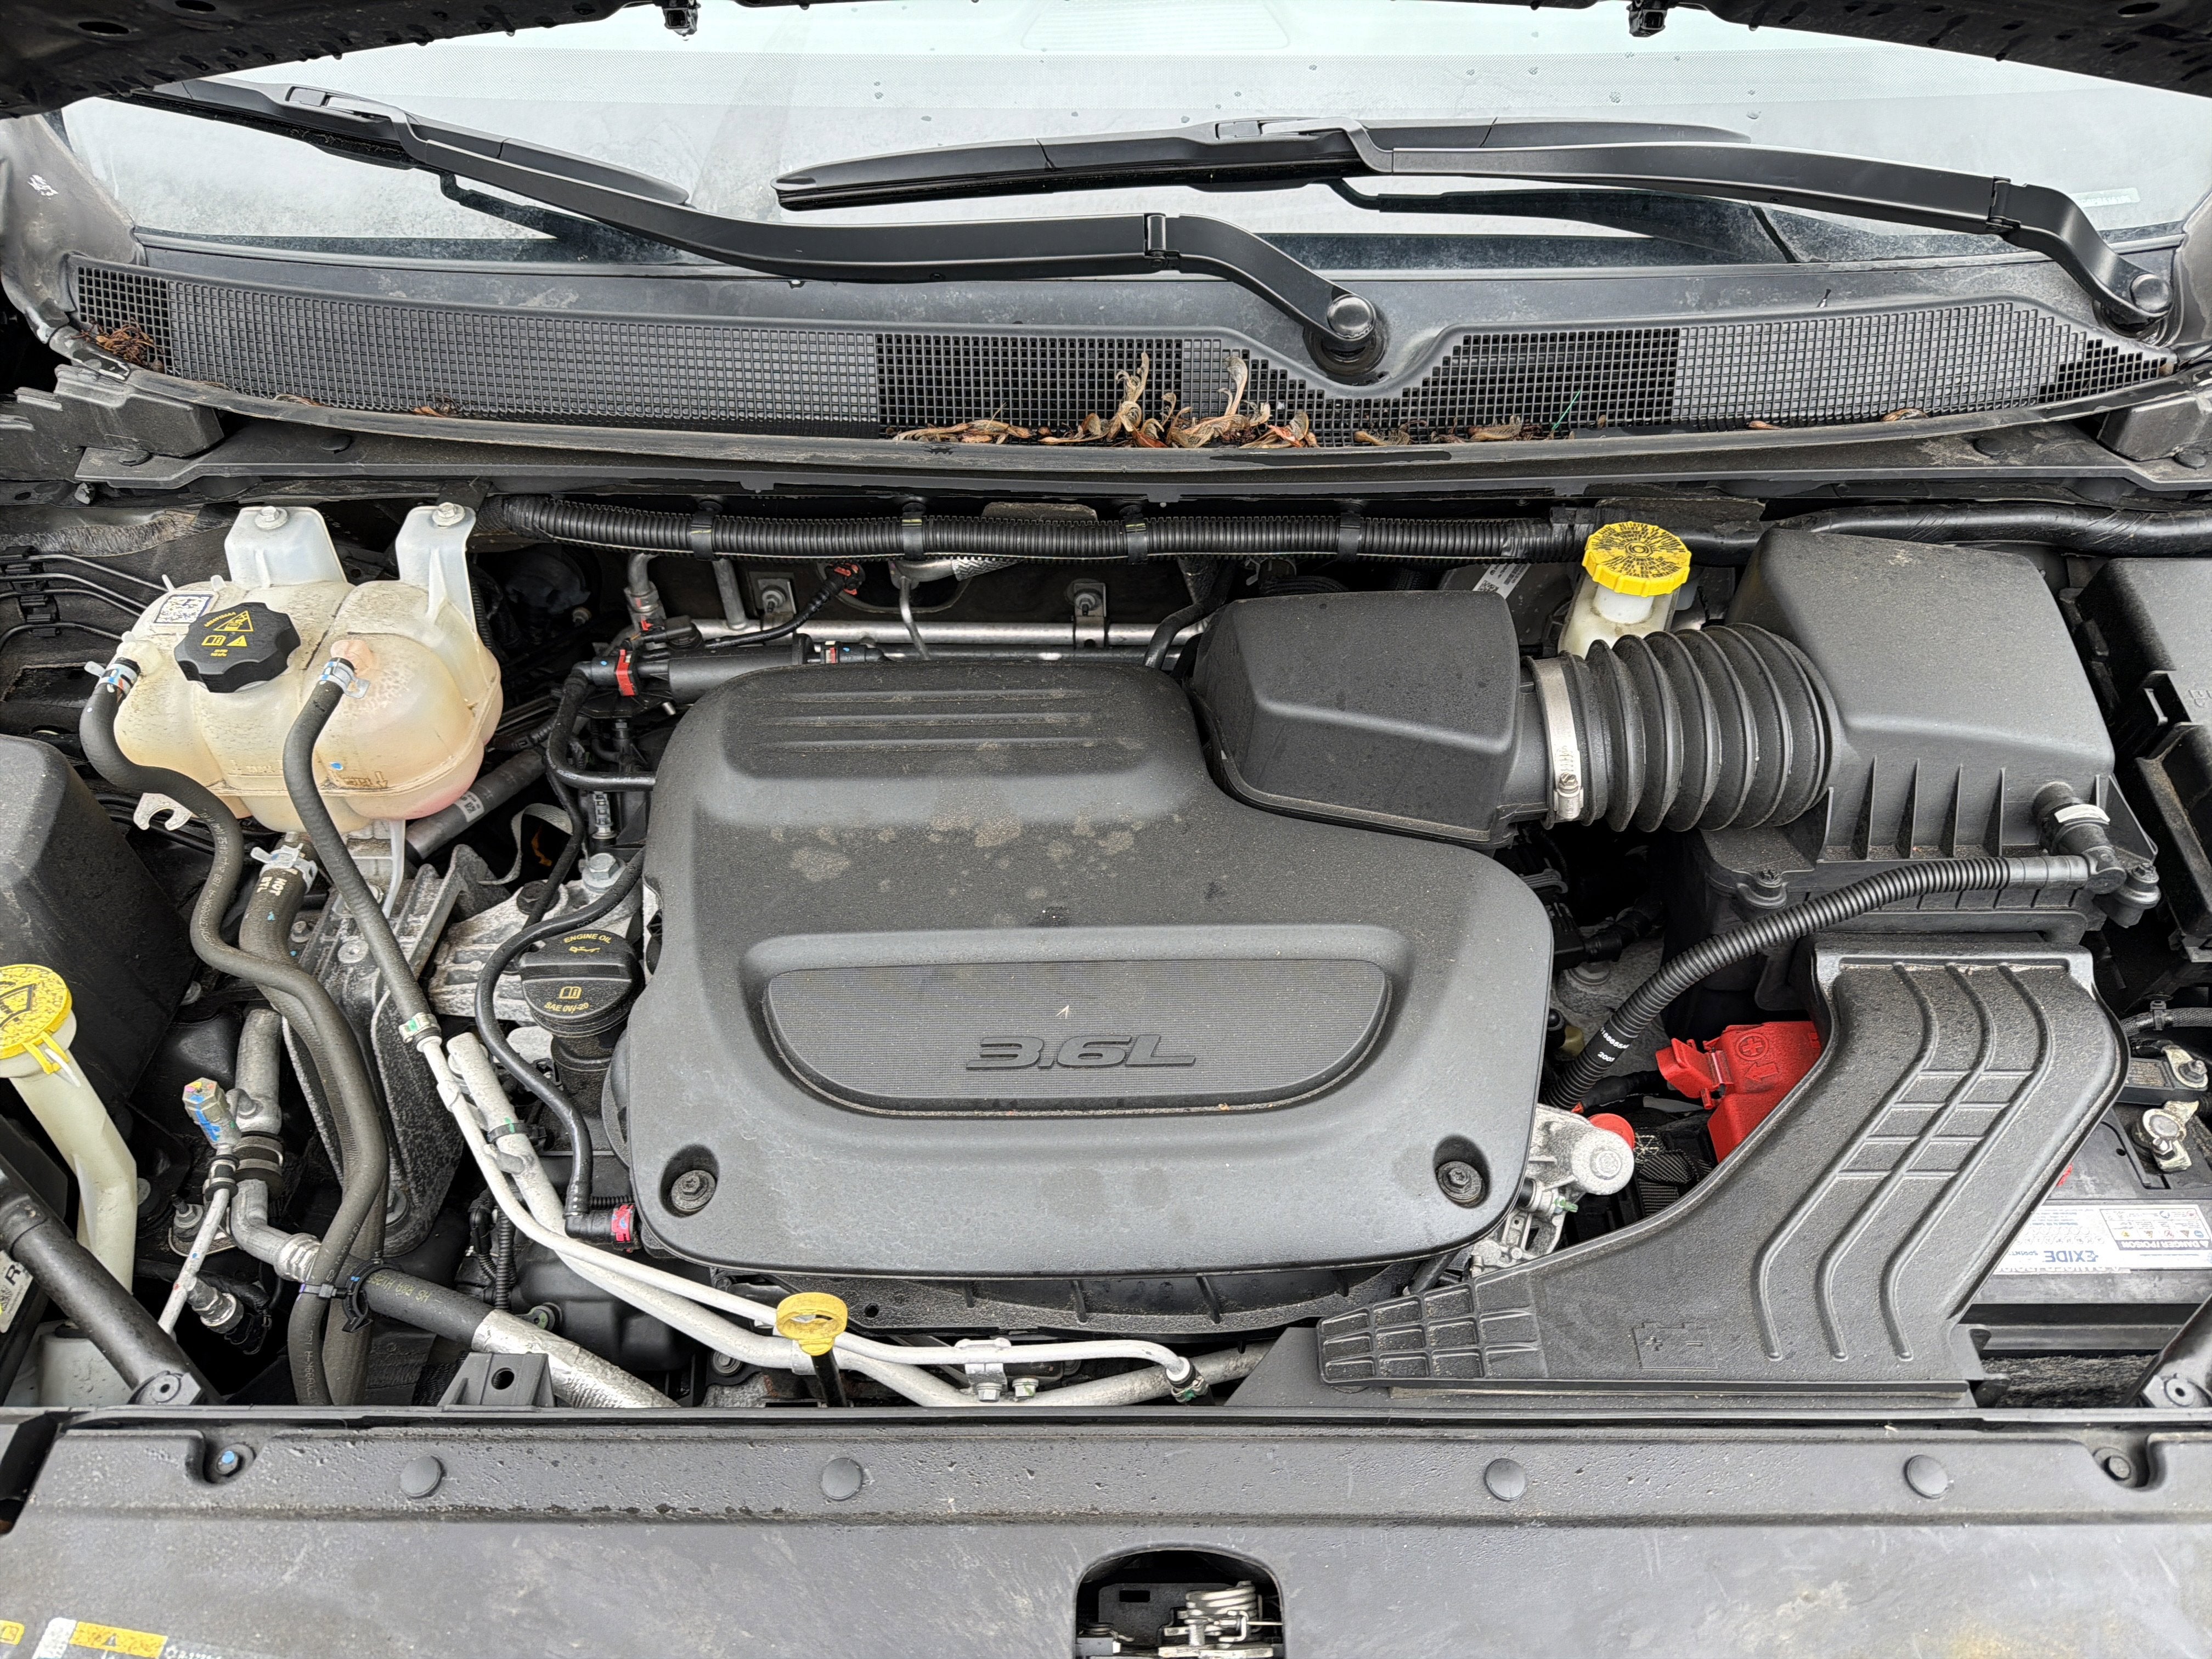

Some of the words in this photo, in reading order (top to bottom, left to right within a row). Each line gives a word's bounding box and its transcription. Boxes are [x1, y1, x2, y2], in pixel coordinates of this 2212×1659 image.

[269, 878, 287, 896] HOT
[564, 934, 598, 943] ENGINE
[598, 935, 612, 944] OIL
[544, 1002, 563, 1012] SAE
[562, 1002, 589, 1013] 0W-20
[966, 1034, 1196, 1070] 3.6L
[2044, 1250, 2099, 1262] EXIDE
[4, 1264, 21, 1286] R
